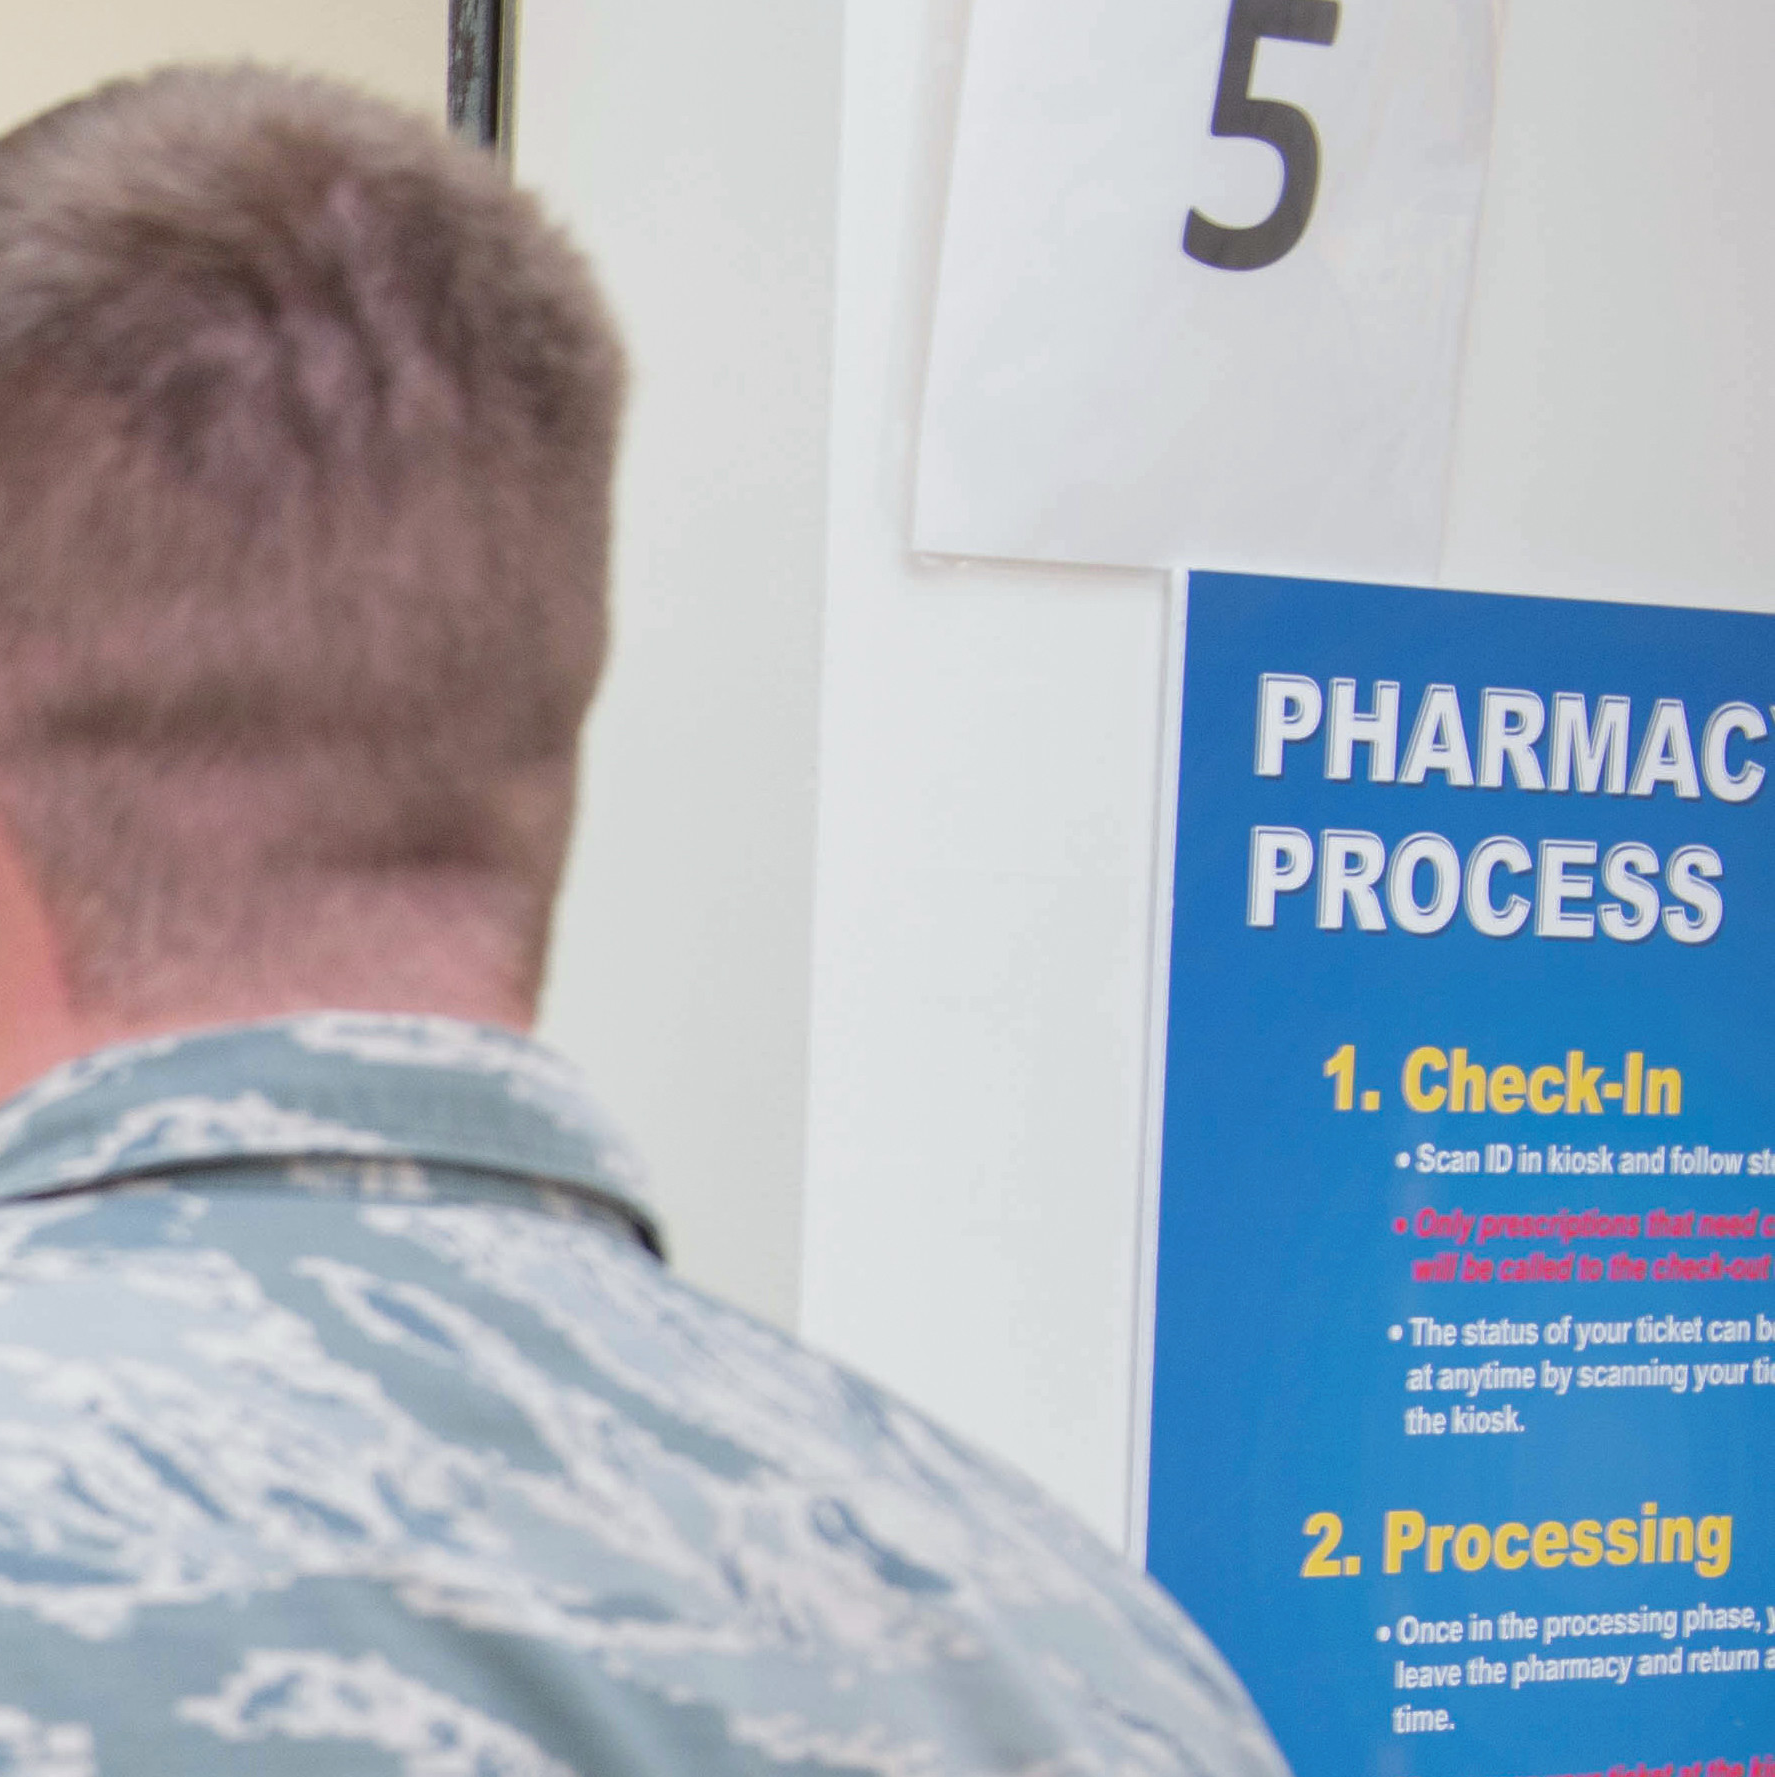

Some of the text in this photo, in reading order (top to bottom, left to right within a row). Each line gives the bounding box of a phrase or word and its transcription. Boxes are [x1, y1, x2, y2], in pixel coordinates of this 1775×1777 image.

[1182, 0, 1341, 272] 5
[1254, 671, 1775, 804] PHARMAC
[1247, 824, 1725, 943] PROCESS
[1323, 1044, 1683, 1116] 1. Check-In
[1416, 1143, 1479, 1174] Scan
[1484, 1144, 1513, 1173] ID
[1517, 1145, 1542, 1174] in
[1547, 1145, 1614, 1175] kiosk
[1618, 1147, 1665, 1175] and
[1669, 1147, 1742, 1176] follow
[1412, 1207, 1475, 1245] Only
[1476, 1209, 1640, 1245] prescriptions
[1646, 1210, 1694, 1238] that
[1698, 1209, 1760, 1238] need
[1412, 1252, 1771, 1282] will be called to the check-out
[1409, 1317, 1457, 1347] The
[1461, 1318, 1539, 1346] status
[1544, 1315, 1573, 1345] of
[1575, 1321, 1632, 1351] your
[1635, 1315, 1702, 1343] ticket
[1707, 1318, 1750, 1342] can
[1406, 1363, 1433, 1391] at
[1436, 1361, 1536, 1397] anytime
[1540, 1360, 1573, 1396] by
[1576, 1357, 1689, 1394] scanning
[1692, 1363, 1749, 1393] your
[1405, 1404, 1526, 1435] the kiosk.
[1300, 1501, 1733, 1579] 2. Processing
[1395, 1614, 1465, 1646] Once
[1467, 1612, 1493, 1643] in
[1497, 1611, 1538, 1641] the
[1542, 1604, 1678, 1645] processing
[1681, 1602, 1762, 1638] phase,
[1394, 1658, 1462, 1690] leave
[1466, 1656, 1508, 1686] the
[1511, 1652, 1633, 1690] pharmacy
[1636, 1647, 1684, 1677] and
[1688, 1643, 1760, 1674] return
[1392, 1703, 1455, 1735] time.
